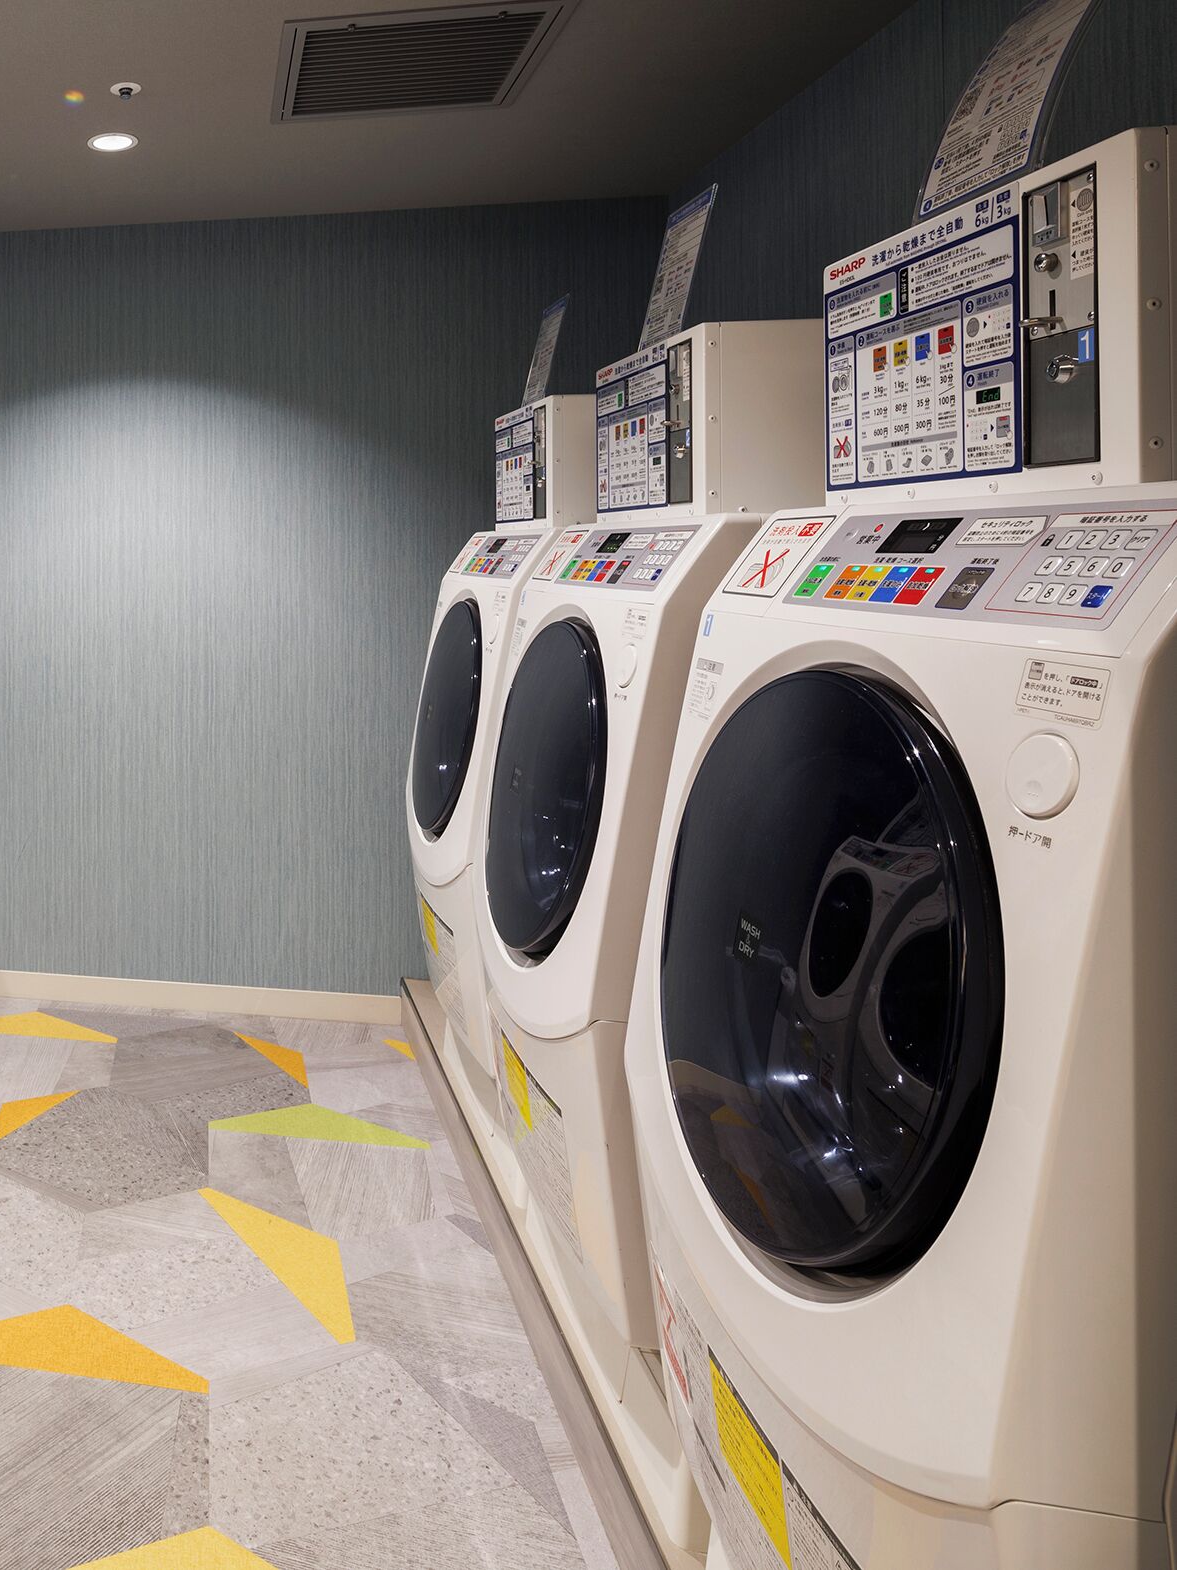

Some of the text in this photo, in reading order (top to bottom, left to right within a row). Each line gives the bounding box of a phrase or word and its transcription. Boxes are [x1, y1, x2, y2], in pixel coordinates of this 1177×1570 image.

[996, 204, 1012, 219] 3kg
[975, 214, 989, 228] 6kg
[872, 216, 964, 267] 洗濯から乾燥まで全自動
[829, 257, 866, 281] SHARP
[1079, 334, 1092, 360] 1
[938, 394, 956, 405] 100円
[916, 419, 932, 430] 300円
[981, 520, 1033, 528] セキュリティロック
[1080, 514, 1148, 524] 暗証番号を入力する
[1065, 535, 1073, 545] 1
[1085, 534, 1097, 545] 2
[1108, 534, 1120, 545] 3
[1043, 560, 1123, 573] 4 5 6 0
[1023, 586, 1033, 597] 7
[1044, 587, 1054, 598] 8
[1066, 588, 1077, 600] 9
[1021, 693, 1063, 708] ことができます。
[741, 918, 761, 940] WASH
[738, 941, 754, 958] DRY
